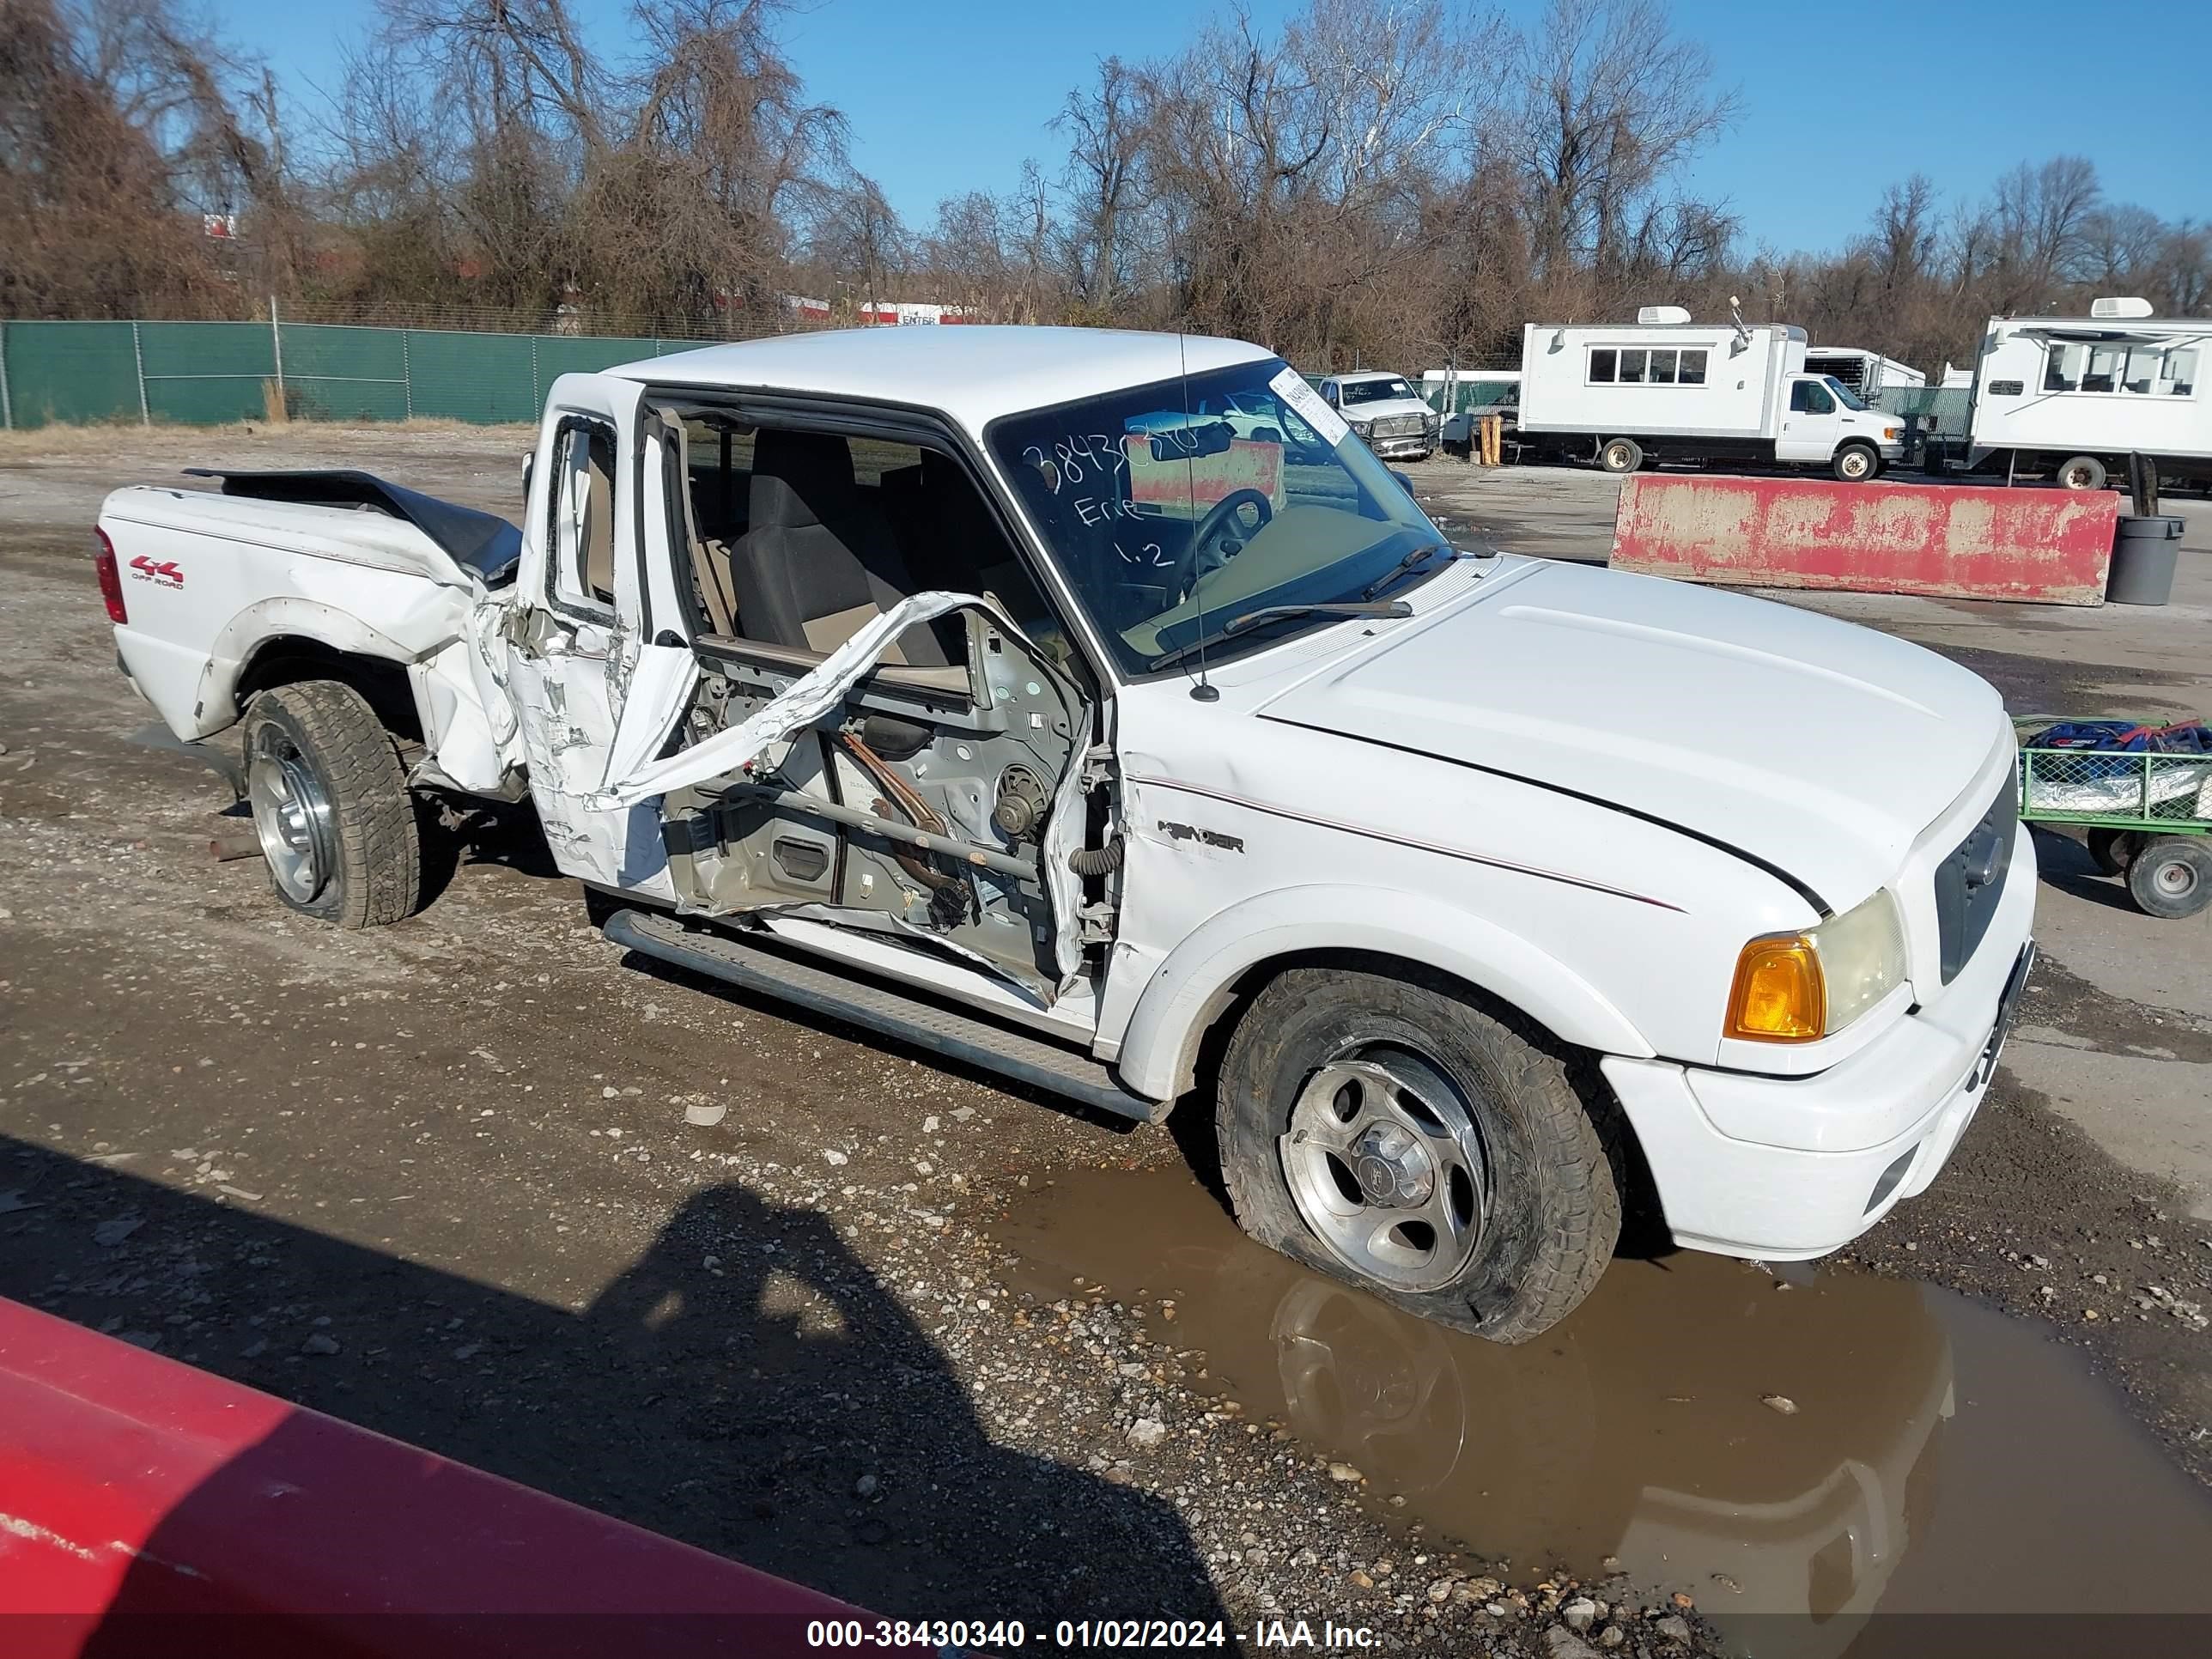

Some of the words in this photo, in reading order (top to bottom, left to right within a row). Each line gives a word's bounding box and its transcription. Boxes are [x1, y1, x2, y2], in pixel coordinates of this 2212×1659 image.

[1074, 497, 1145, 527] Erie
[1114, 542, 1176, 567] 1.2
[131, 573, 151, 581] OFF
[155, 578, 184, 590] ROAD
